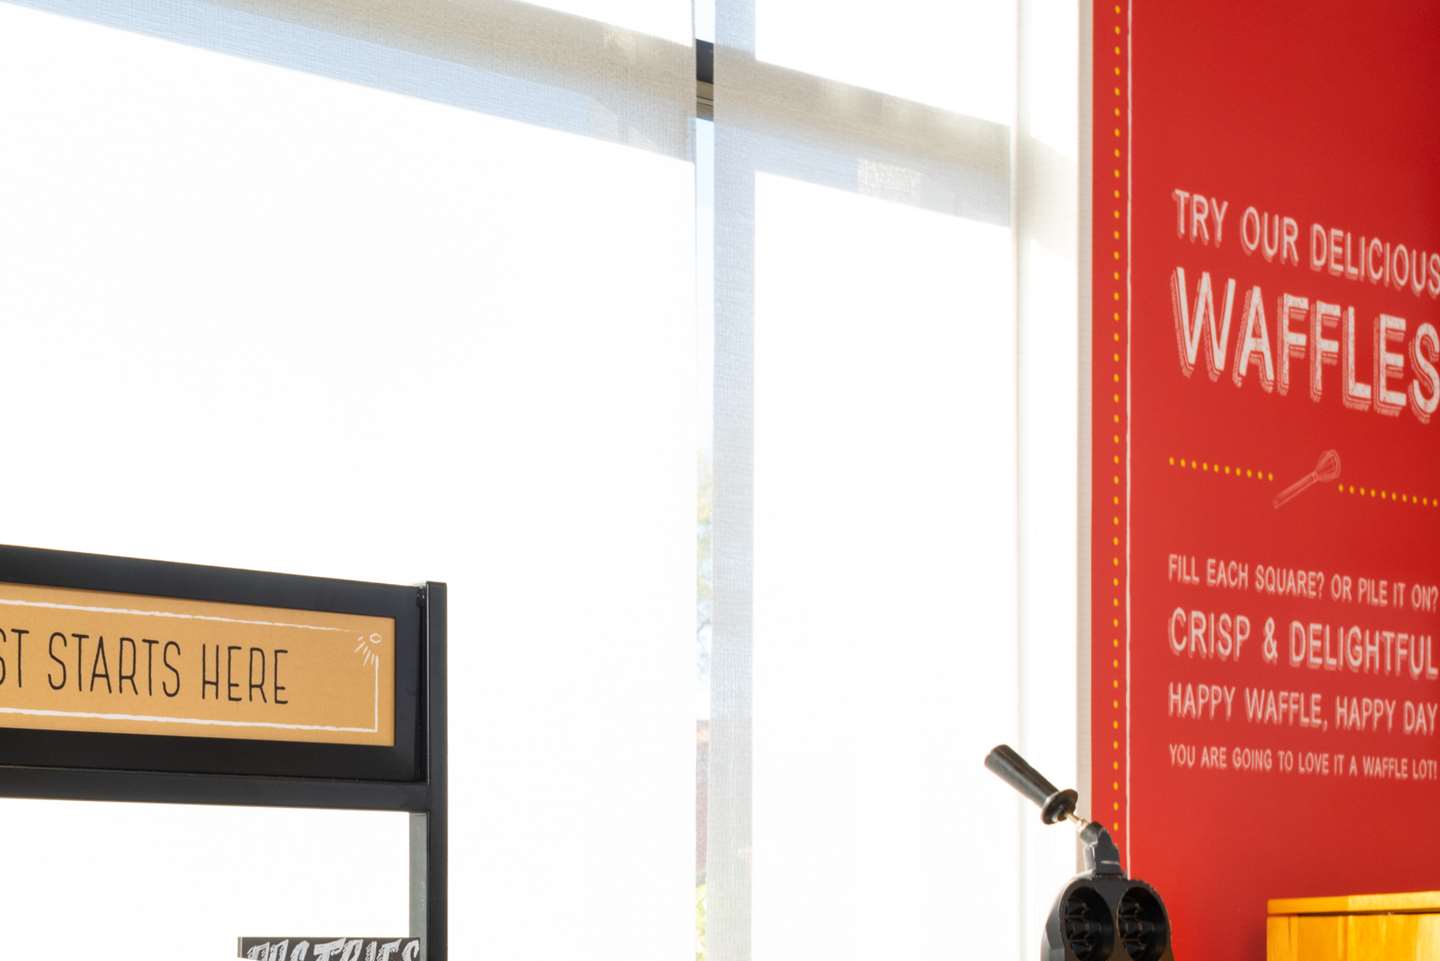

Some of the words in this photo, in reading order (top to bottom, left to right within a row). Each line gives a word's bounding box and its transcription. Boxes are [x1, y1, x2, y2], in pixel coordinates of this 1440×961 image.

[1172, 188, 1229, 248] TRY
[1241, 206, 1299, 266] OUR
[1311, 223, 1440, 299] DELICIOUS
[1171, 266, 1440, 424] WAFFLES
[1168, 554, 1200, 583] FILL
[1207, 558, 1249, 589] EACH
[1255, 564, 1325, 599] SQUARE?
[1331, 574, 1353, 601] OR
[1358, 577, 1388, 607] PILE
[1393, 581, 1406, 609] IT
[1411, 584, 1439, 612] ON?
[48, 631, 182, 698] STARTS
[202, 641, 289, 705] HERE
[1168, 607, 1251, 662] CRISP
[1263, 617, 1278, 667] &
[1289, 619, 1439, 680] DELIGHTFUL
[1168, 682, 1236, 722] HAPPY
[1244, 687, 1328, 731] WAFFLE,
[1335, 696, 1396, 735] HAPPY
[1403, 701, 1438, 736] DAY
[1169, 743, 1195, 768] YOU
[1200, 746, 1227, 769] ARE
[1232, 747, 1273, 771] GOING
[1278, 750, 1293, 772] TO
[1298, 751, 1329, 775] LOVE
[1334, 753, 1345, 775] IT
[1349, 754, 1358, 777] A
[1363, 756, 1408, 780] WAFFLE
[1412, 759, 1438, 781] LOT!
